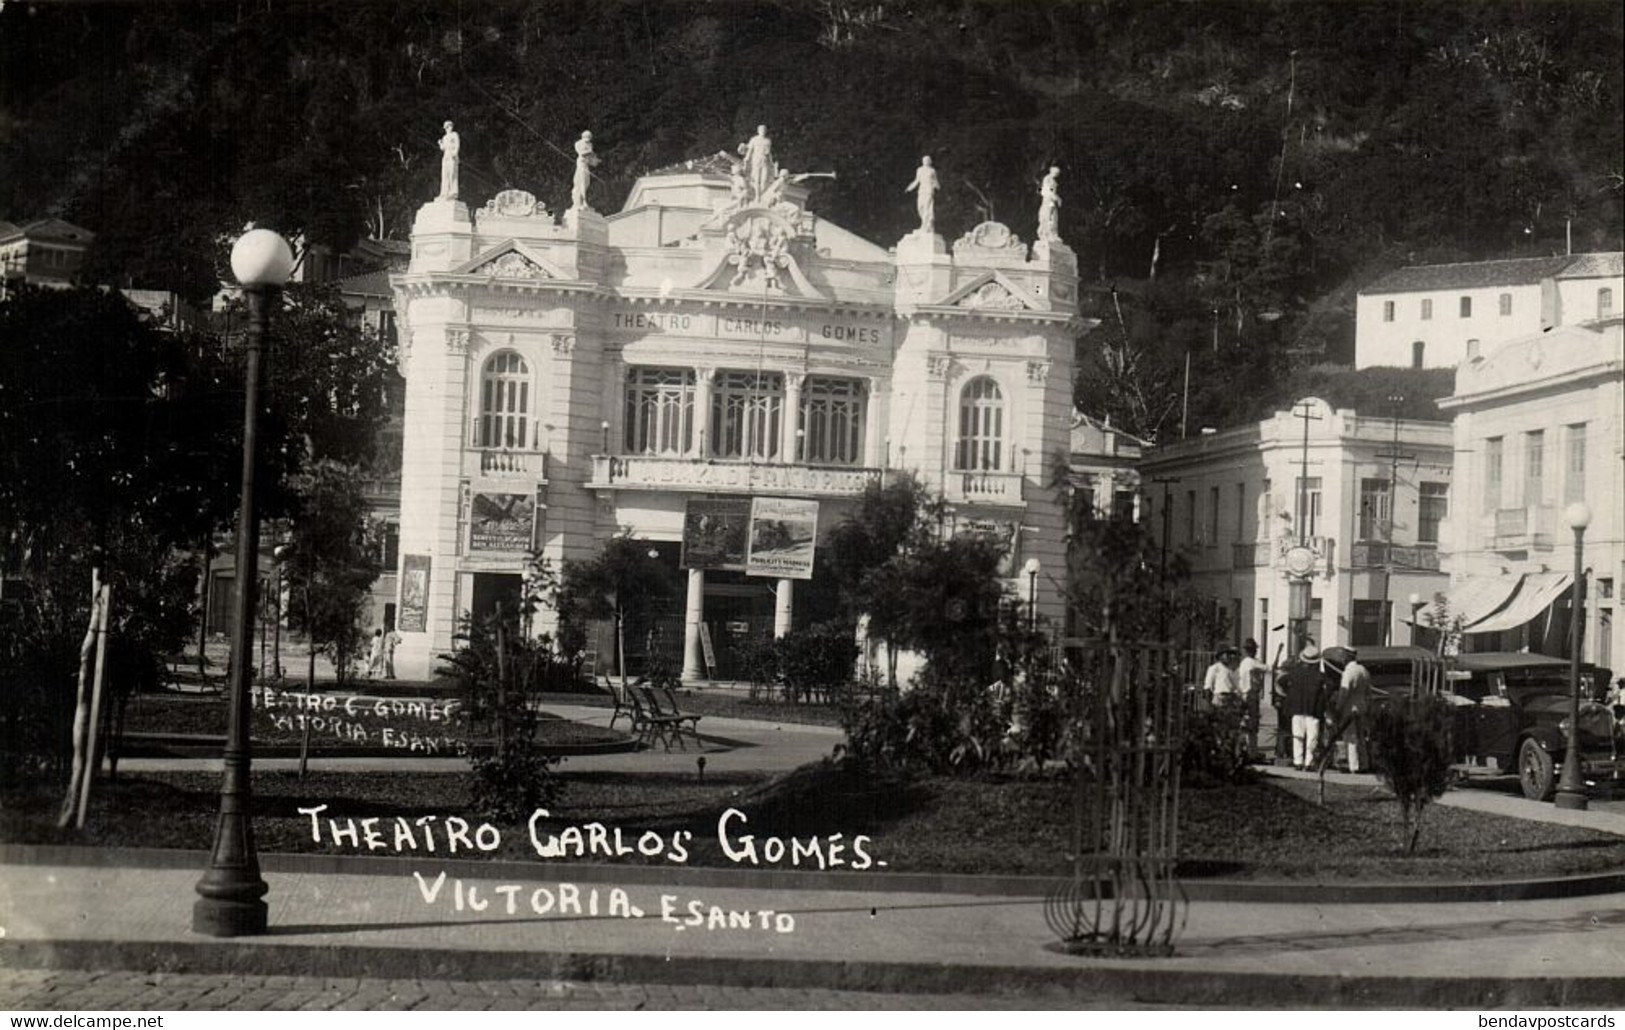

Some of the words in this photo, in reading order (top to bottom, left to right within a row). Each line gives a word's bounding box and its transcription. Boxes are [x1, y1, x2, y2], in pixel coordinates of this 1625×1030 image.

[614, 311, 691, 330] THEATRO
[724, 317, 782, 336] CARLOS
[822, 324, 880, 344] GOMES
